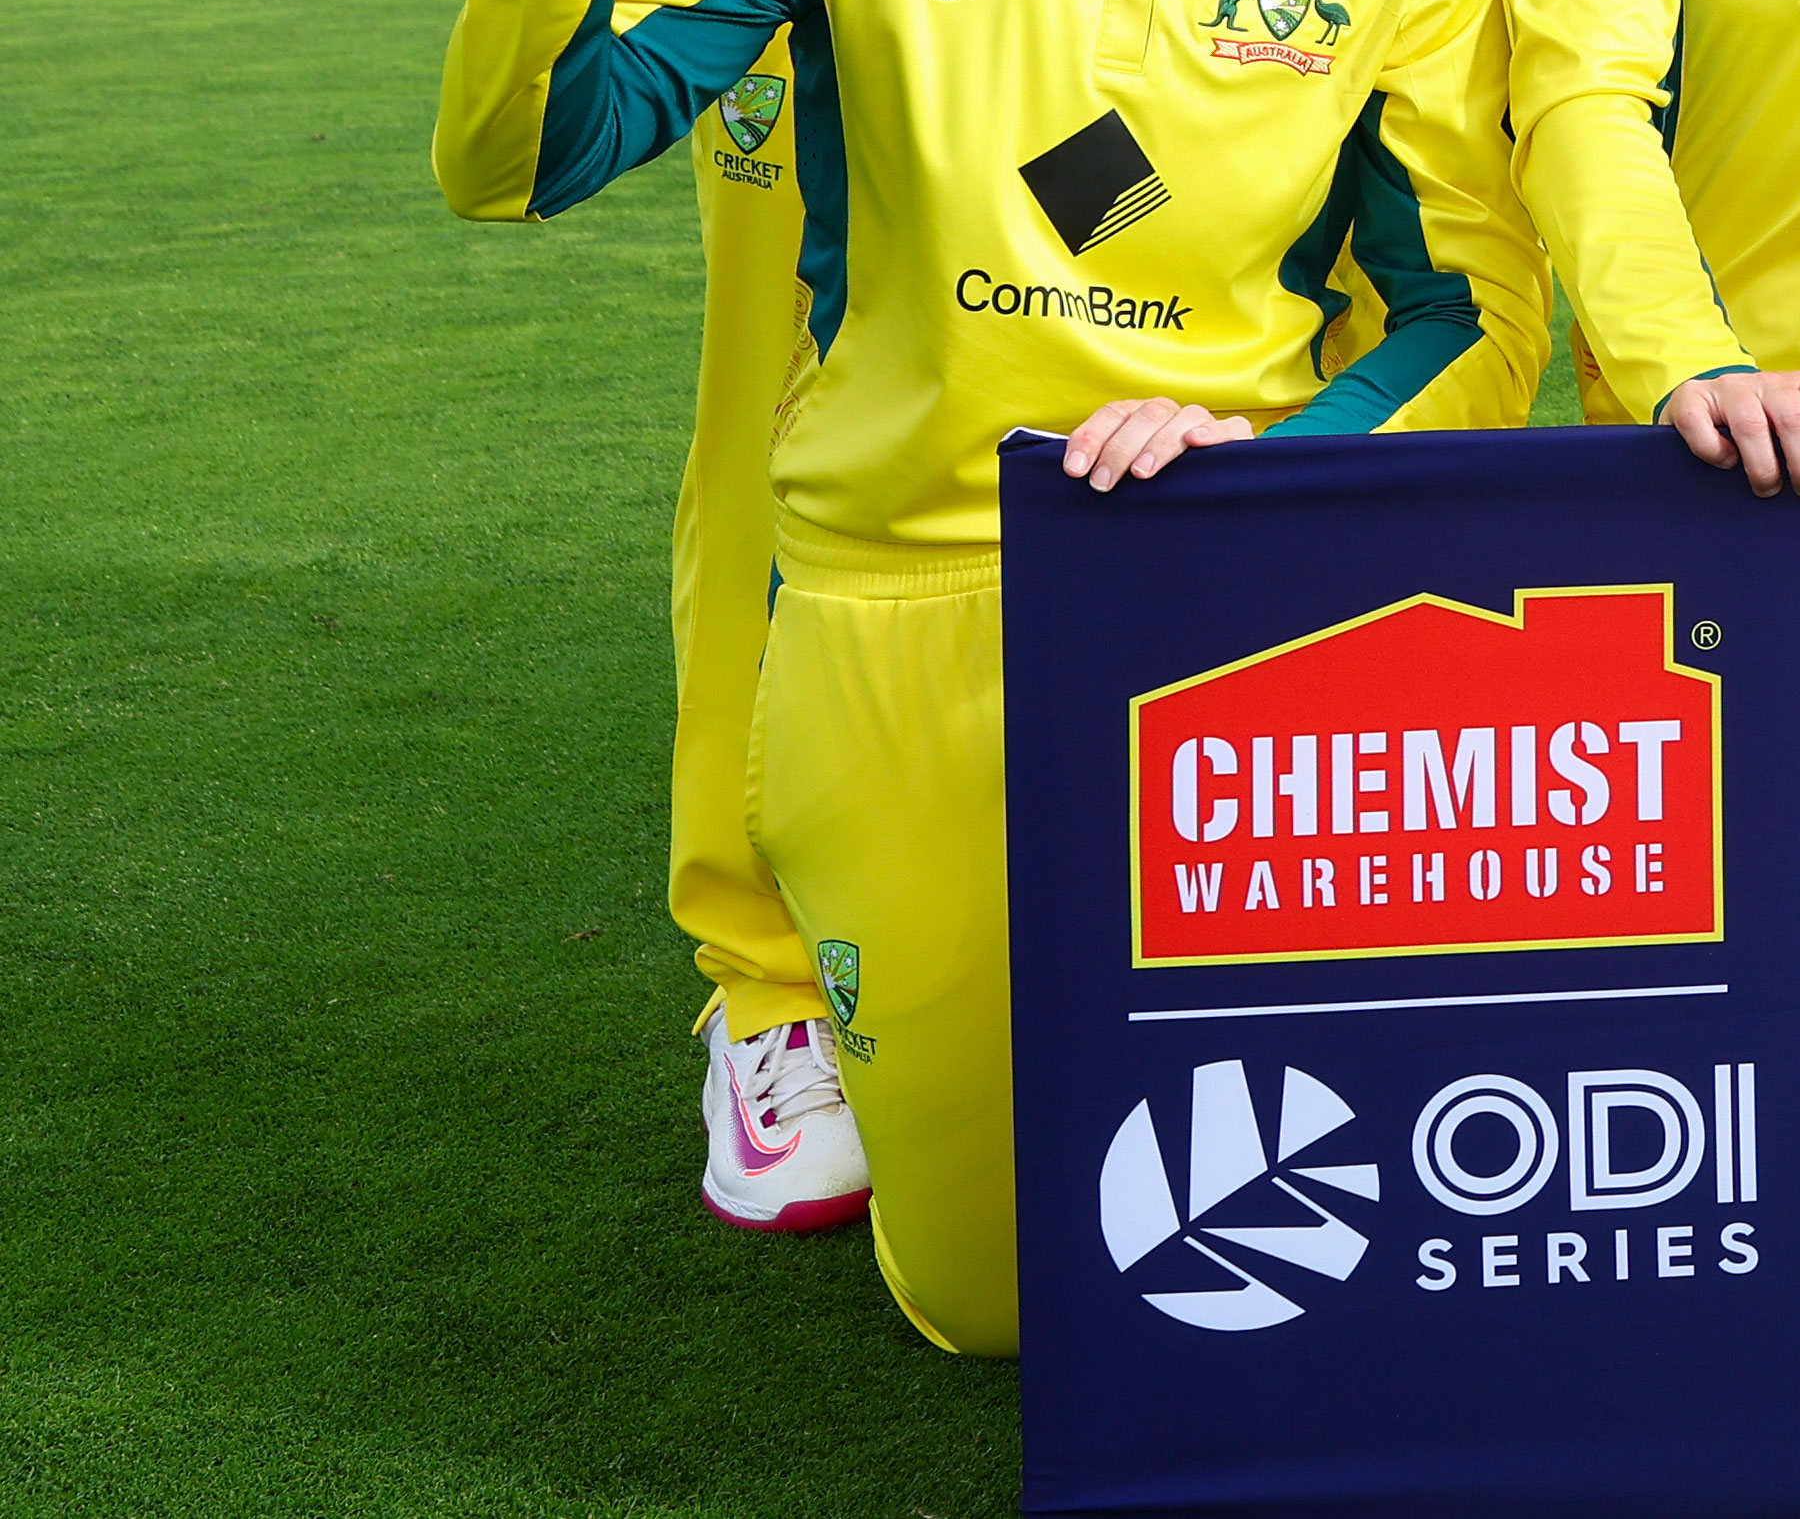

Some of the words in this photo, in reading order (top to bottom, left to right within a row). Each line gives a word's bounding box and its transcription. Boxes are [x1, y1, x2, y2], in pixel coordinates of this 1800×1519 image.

[1245, 46, 1309, 72] AUSTRALIA
[714, 150, 784, 182] CRICKET
[721, 169, 773, 191] AUSTRALIA
[956, 267, 1196, 331] CommBank
[1171, 719, 1681, 842] CHEMIST
[1173, 842, 1665, 914] WAREHOUSE
[1412, 1063, 1757, 1216] ODI
[1415, 1222, 1760, 1292] SERIES
